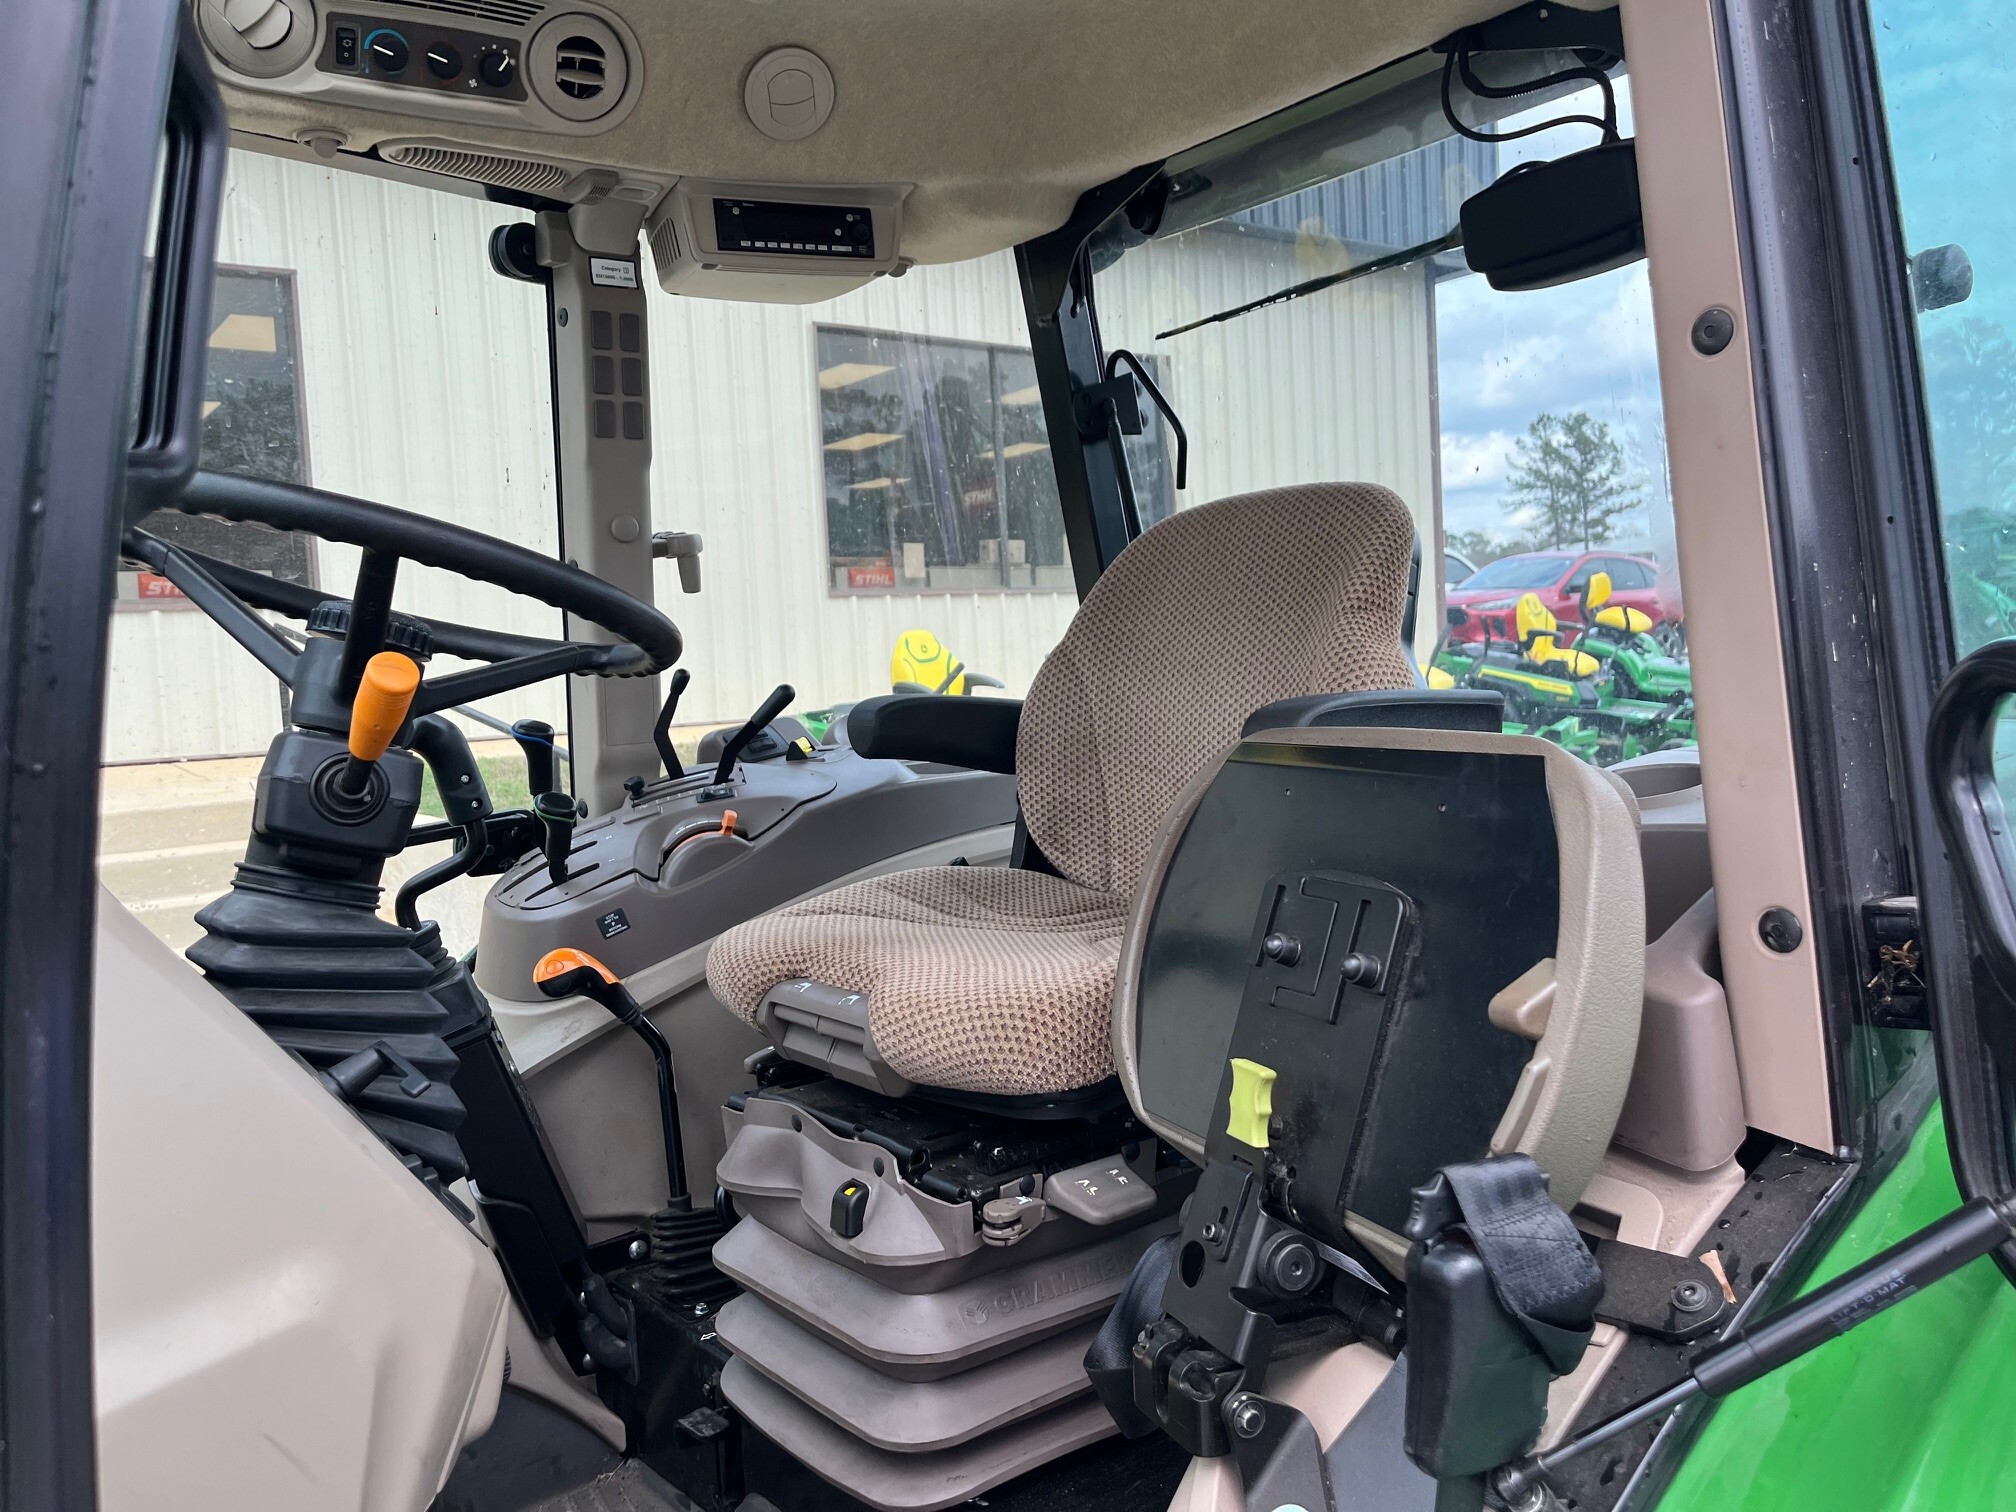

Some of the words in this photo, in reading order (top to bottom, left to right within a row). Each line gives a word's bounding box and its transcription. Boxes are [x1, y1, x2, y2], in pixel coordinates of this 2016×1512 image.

[601, 265, 622, 273] Category
[855, 574, 893, 585] STIHL
[993, 1252, 1133, 1315] GRAMMER
